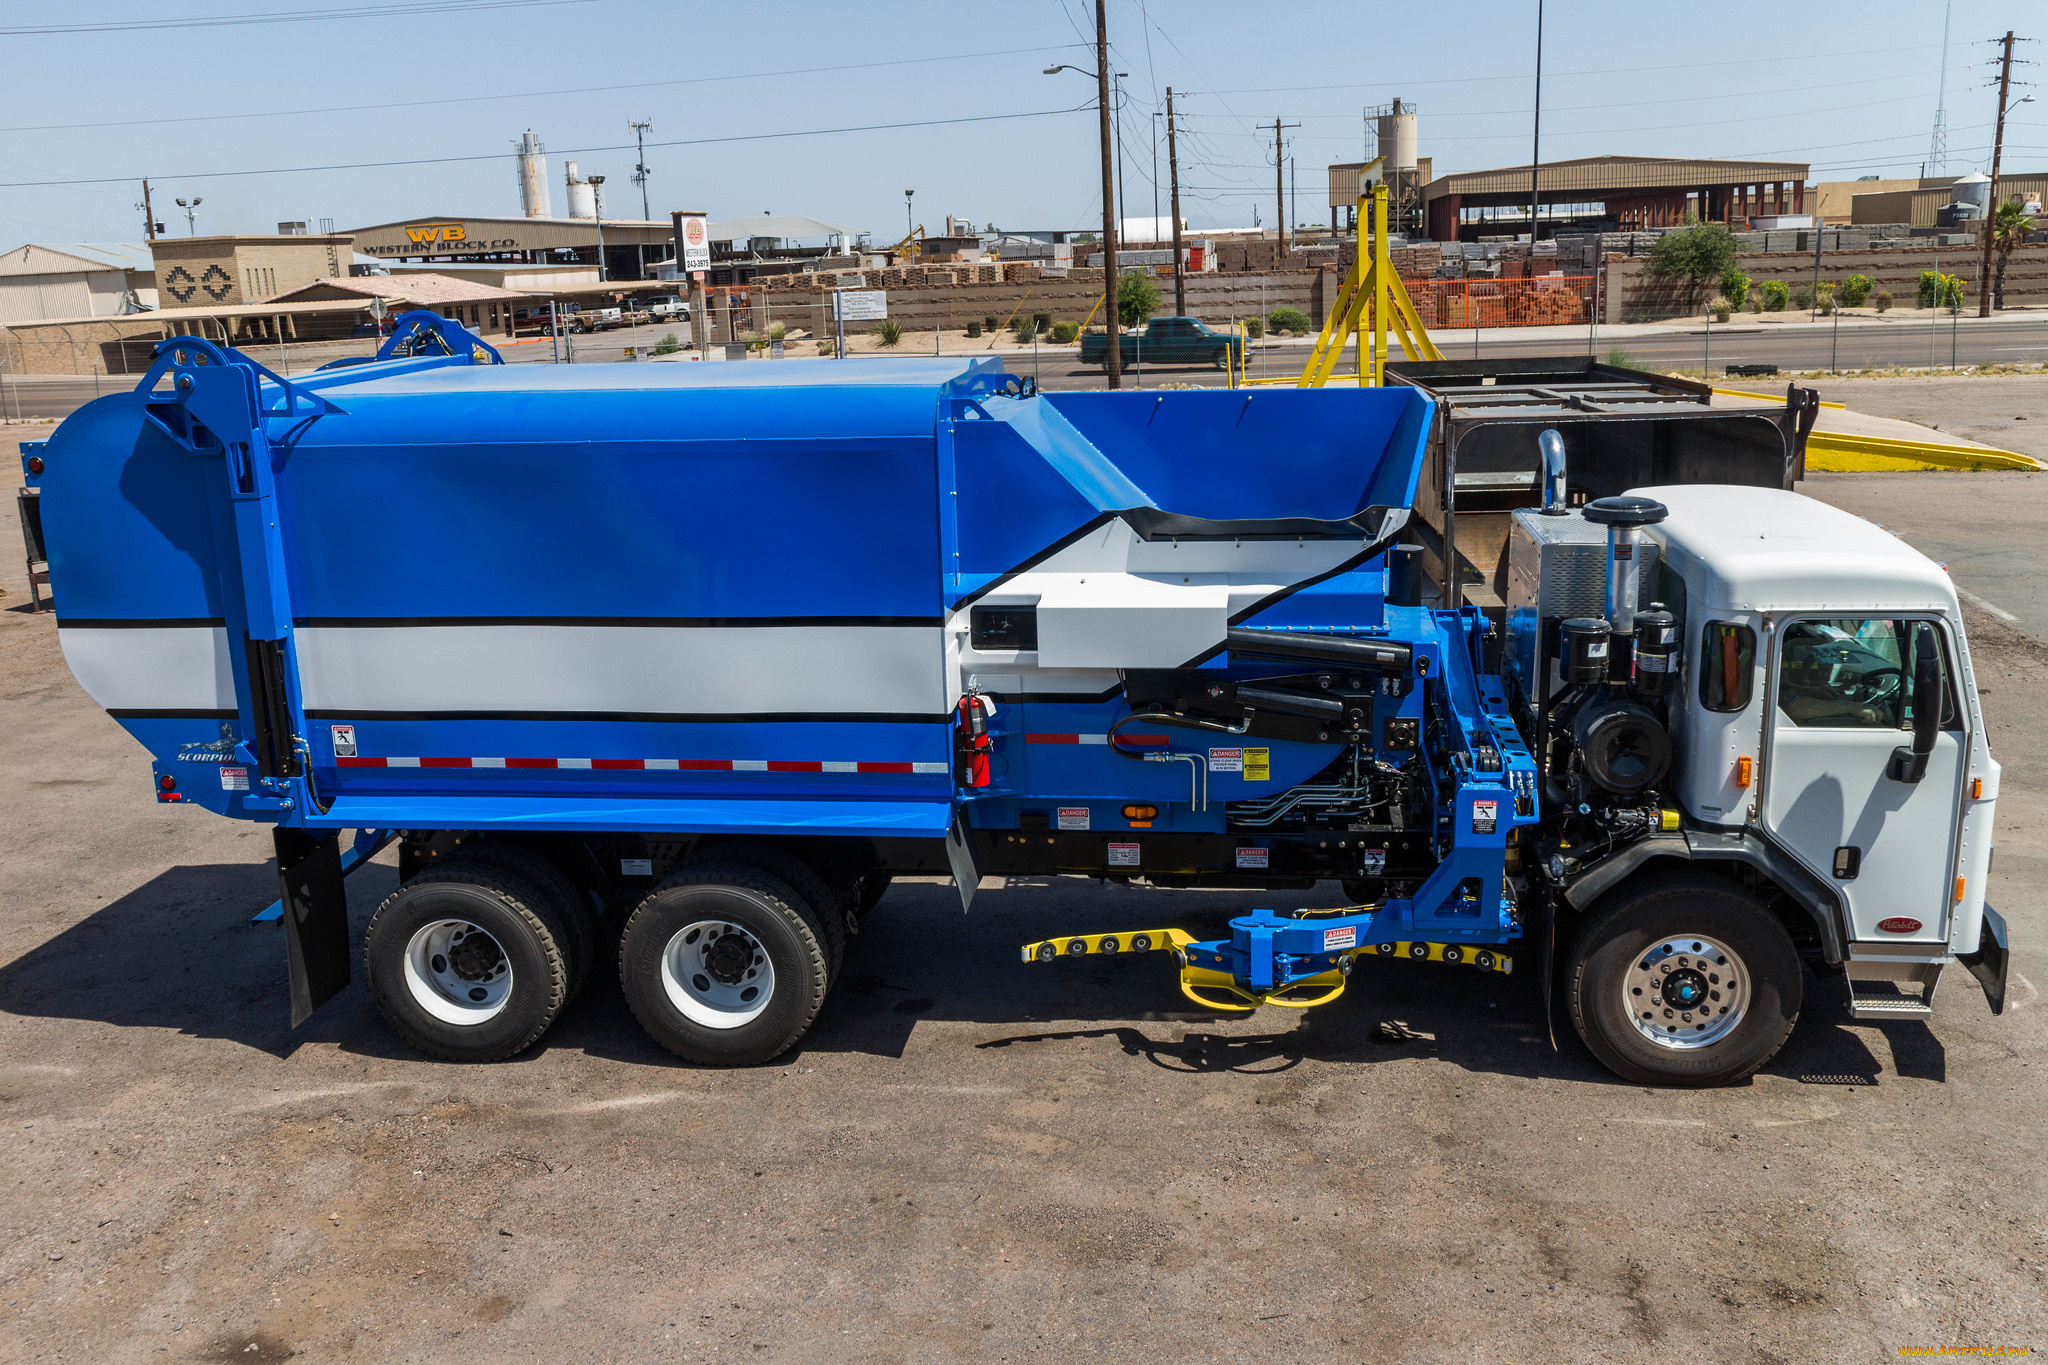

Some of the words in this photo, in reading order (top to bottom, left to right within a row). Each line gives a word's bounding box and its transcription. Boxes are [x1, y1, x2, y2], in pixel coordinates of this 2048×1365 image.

[406, 228, 466, 242] WB
[689, 227, 702, 235] WB
[363, 244, 432, 254] WESTERN
[437, 241, 487, 252] BLOCK
[490, 239, 519, 249] CO.
[1883, 920, 1919, 929] Peterbilt
